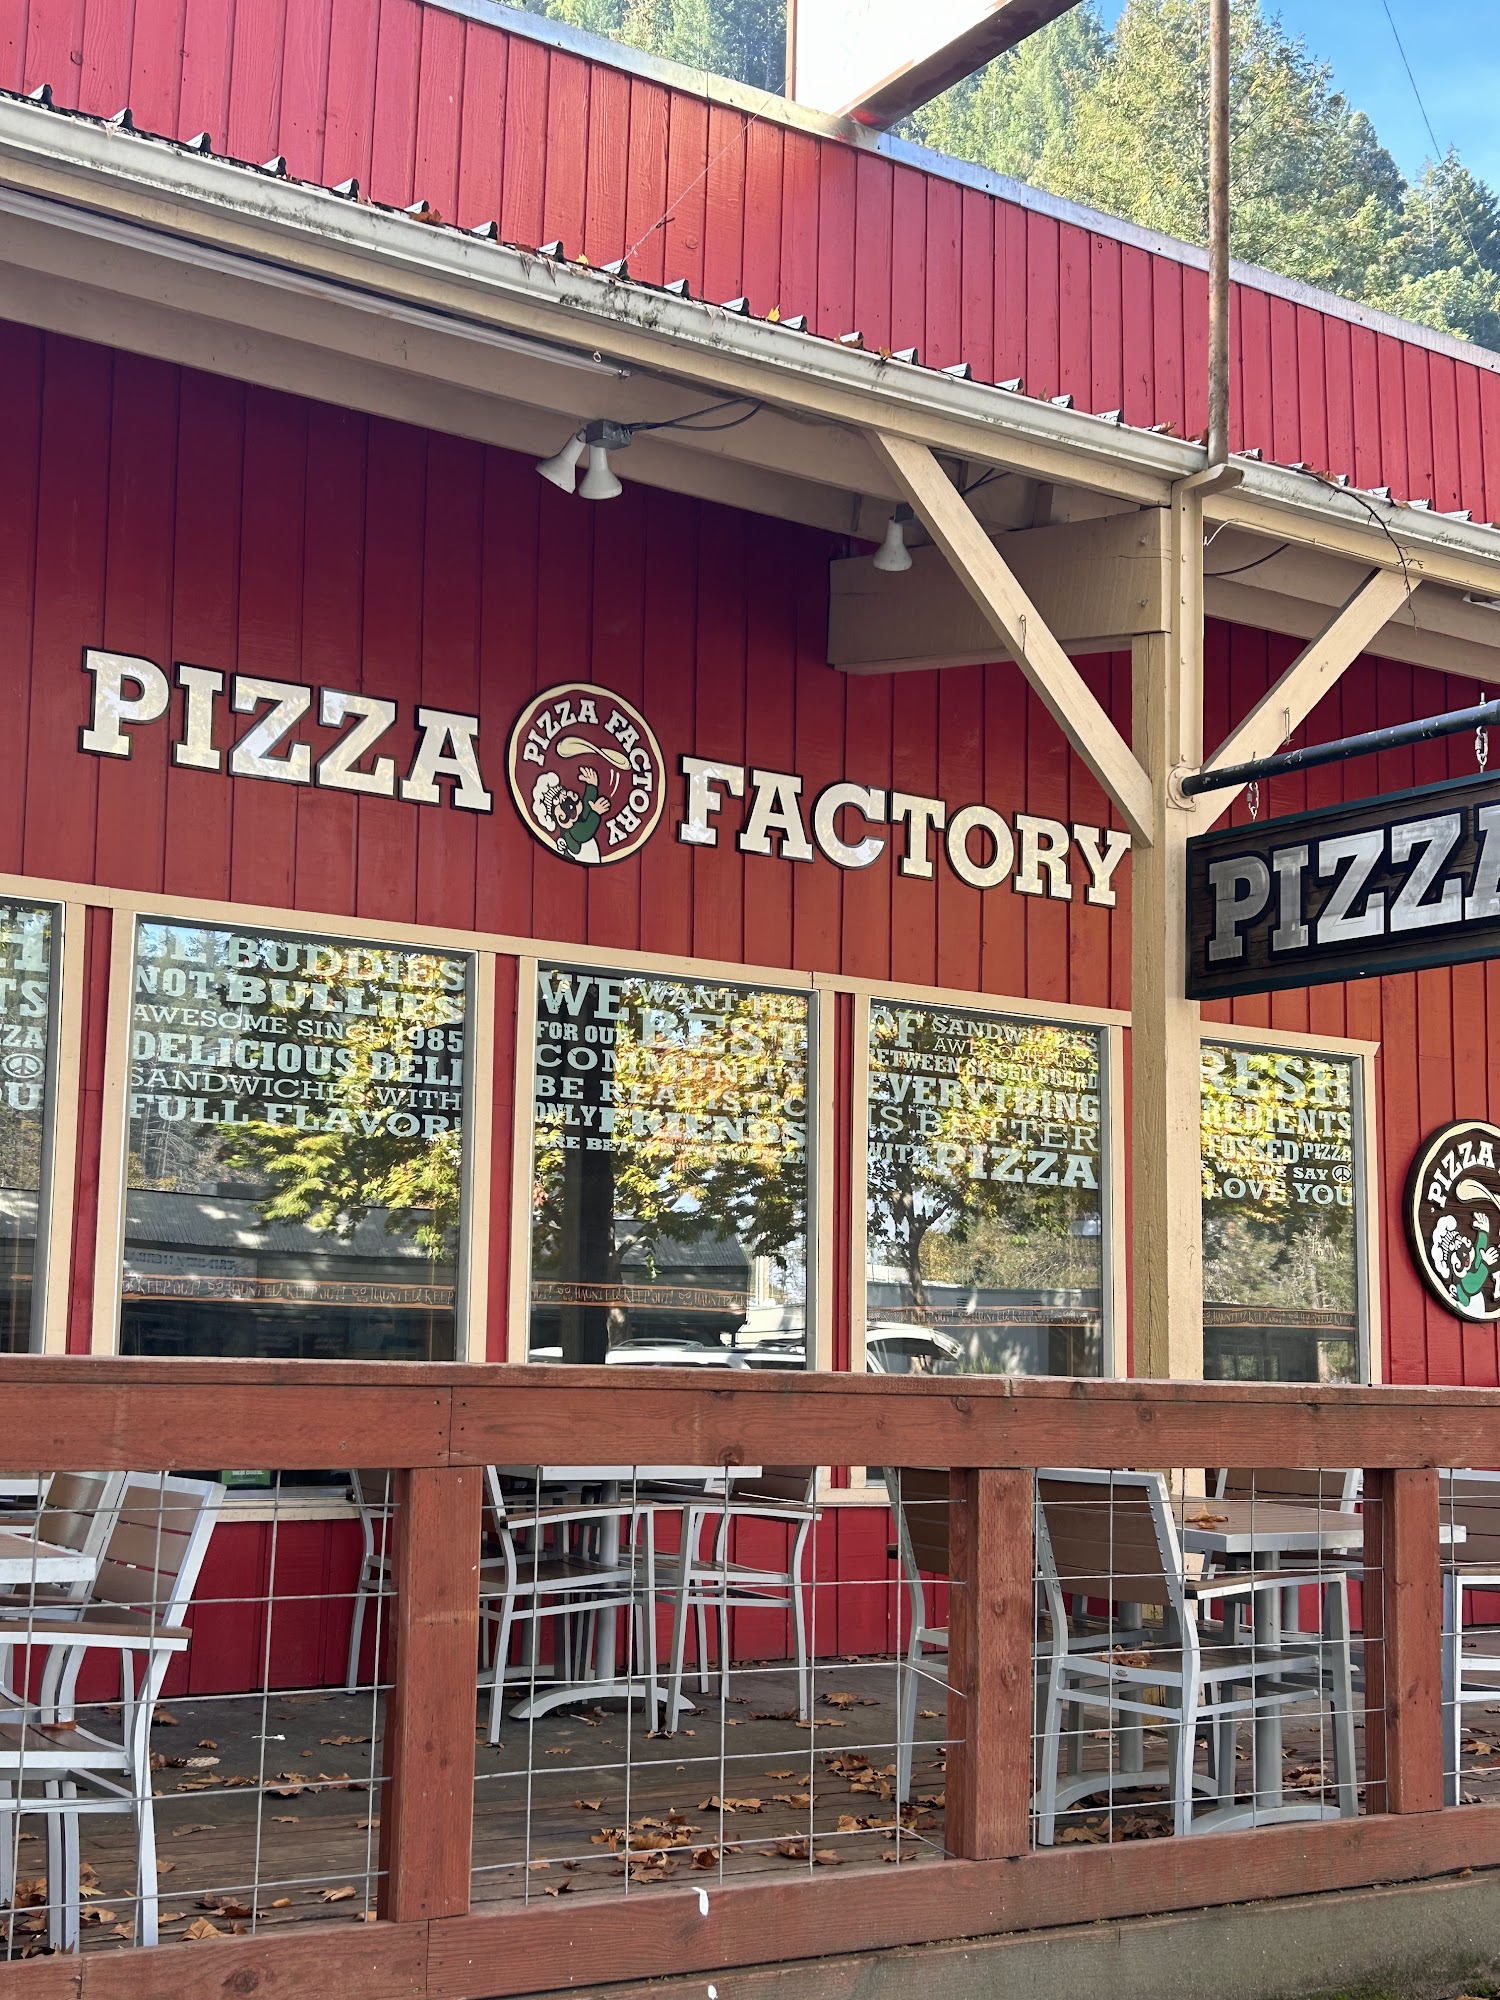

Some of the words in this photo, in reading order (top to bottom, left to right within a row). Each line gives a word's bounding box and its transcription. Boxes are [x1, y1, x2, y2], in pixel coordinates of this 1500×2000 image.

[80, 647, 493, 813] PIZZA
[522, 699, 599, 767] PIZZA
[603, 709, 654, 846] FACTORY
[679, 756, 1132, 907] FACTORY
[226, 937, 465, 991] BUDDIES
[136, 965, 215, 1000] NOT
[226, 974, 465, 1025] BULLIES
[537, 971, 629, 1021] WE
[637, 980, 739, 1012] WANT
[134, 1003, 287, 1034] AWESOME
[296, 1019, 384, 1043] SINCE
[394, 1023, 463, 1053] 1985
[537, 1021, 579, 1041] FOR
[584, 1025, 636, 1046] OUR
[637, 1007, 808, 1062] BEST
[132, 1030, 356, 1077] DELICIOUS
[370, 1051, 462, 1087] DELI
[536, 1043, 806, 1087] COMMUNITY
[869, 1047, 961, 1074] BETWEEN
[129, 1093, 249, 1124] FULL
[131, 1066, 366, 1103] SANDWICHES
[373, 1086, 462, 1111] WITH
[536, 1074, 584, 1099] BE
[599, 1079, 807, 1117] REALISTIC
[868, 1071, 1099, 1123] EVERYTHING
[536, 1101, 598, 1127] ONLY
[599, 1106, 806, 1149] FRIENDS
[868, 1104, 905, 1135] IS
[916, 1109, 1099, 1152] BETTER
[934, 1141, 1099, 1189] PIZZA
[1293, 1167, 1329, 1181] SAY
[1302, 1142, 1351, 1162] PIZZA
[1427, 1140, 1496, 1209] PIZZA
[1204, 1177, 1287, 1201] LOVE
[1292, 1182, 1353, 1206] YOU
